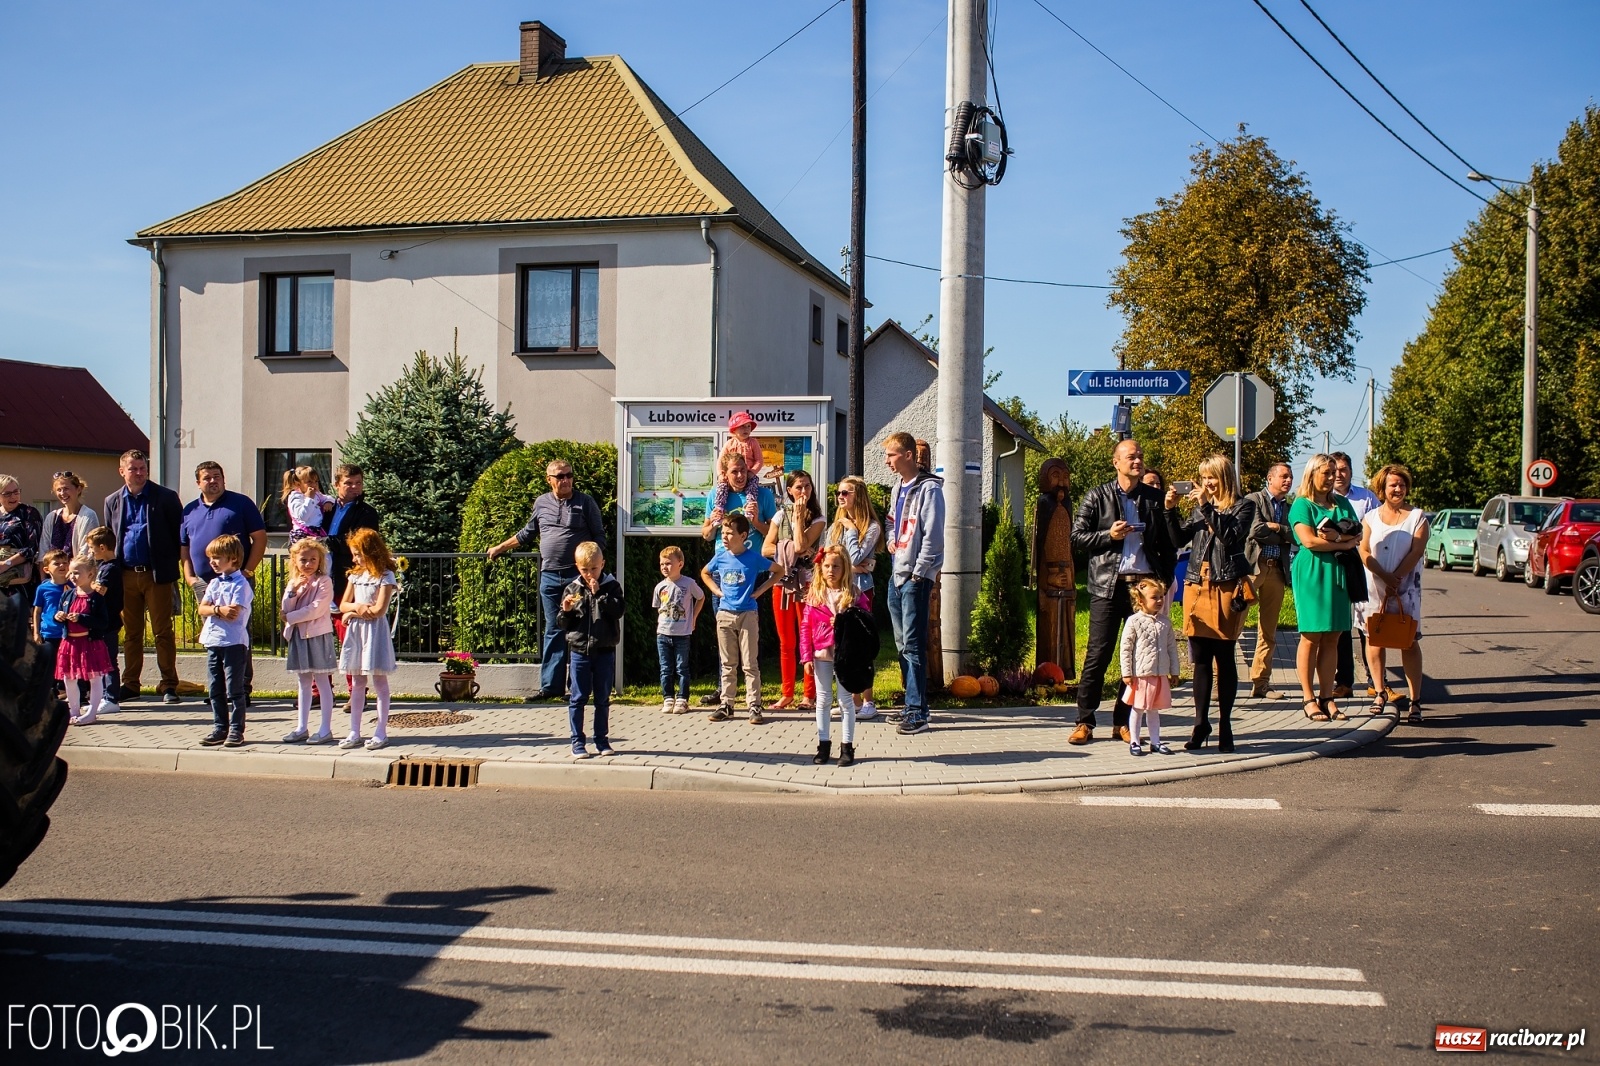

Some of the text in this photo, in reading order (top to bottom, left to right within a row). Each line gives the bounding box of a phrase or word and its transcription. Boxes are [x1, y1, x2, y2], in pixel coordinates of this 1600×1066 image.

[1089, 376, 1169, 388] ul. Eichendorffa
[648, 410, 716, 423] Łubowice
[173, 428, 196, 449] 21
[1531, 467, 1553, 480] 40
